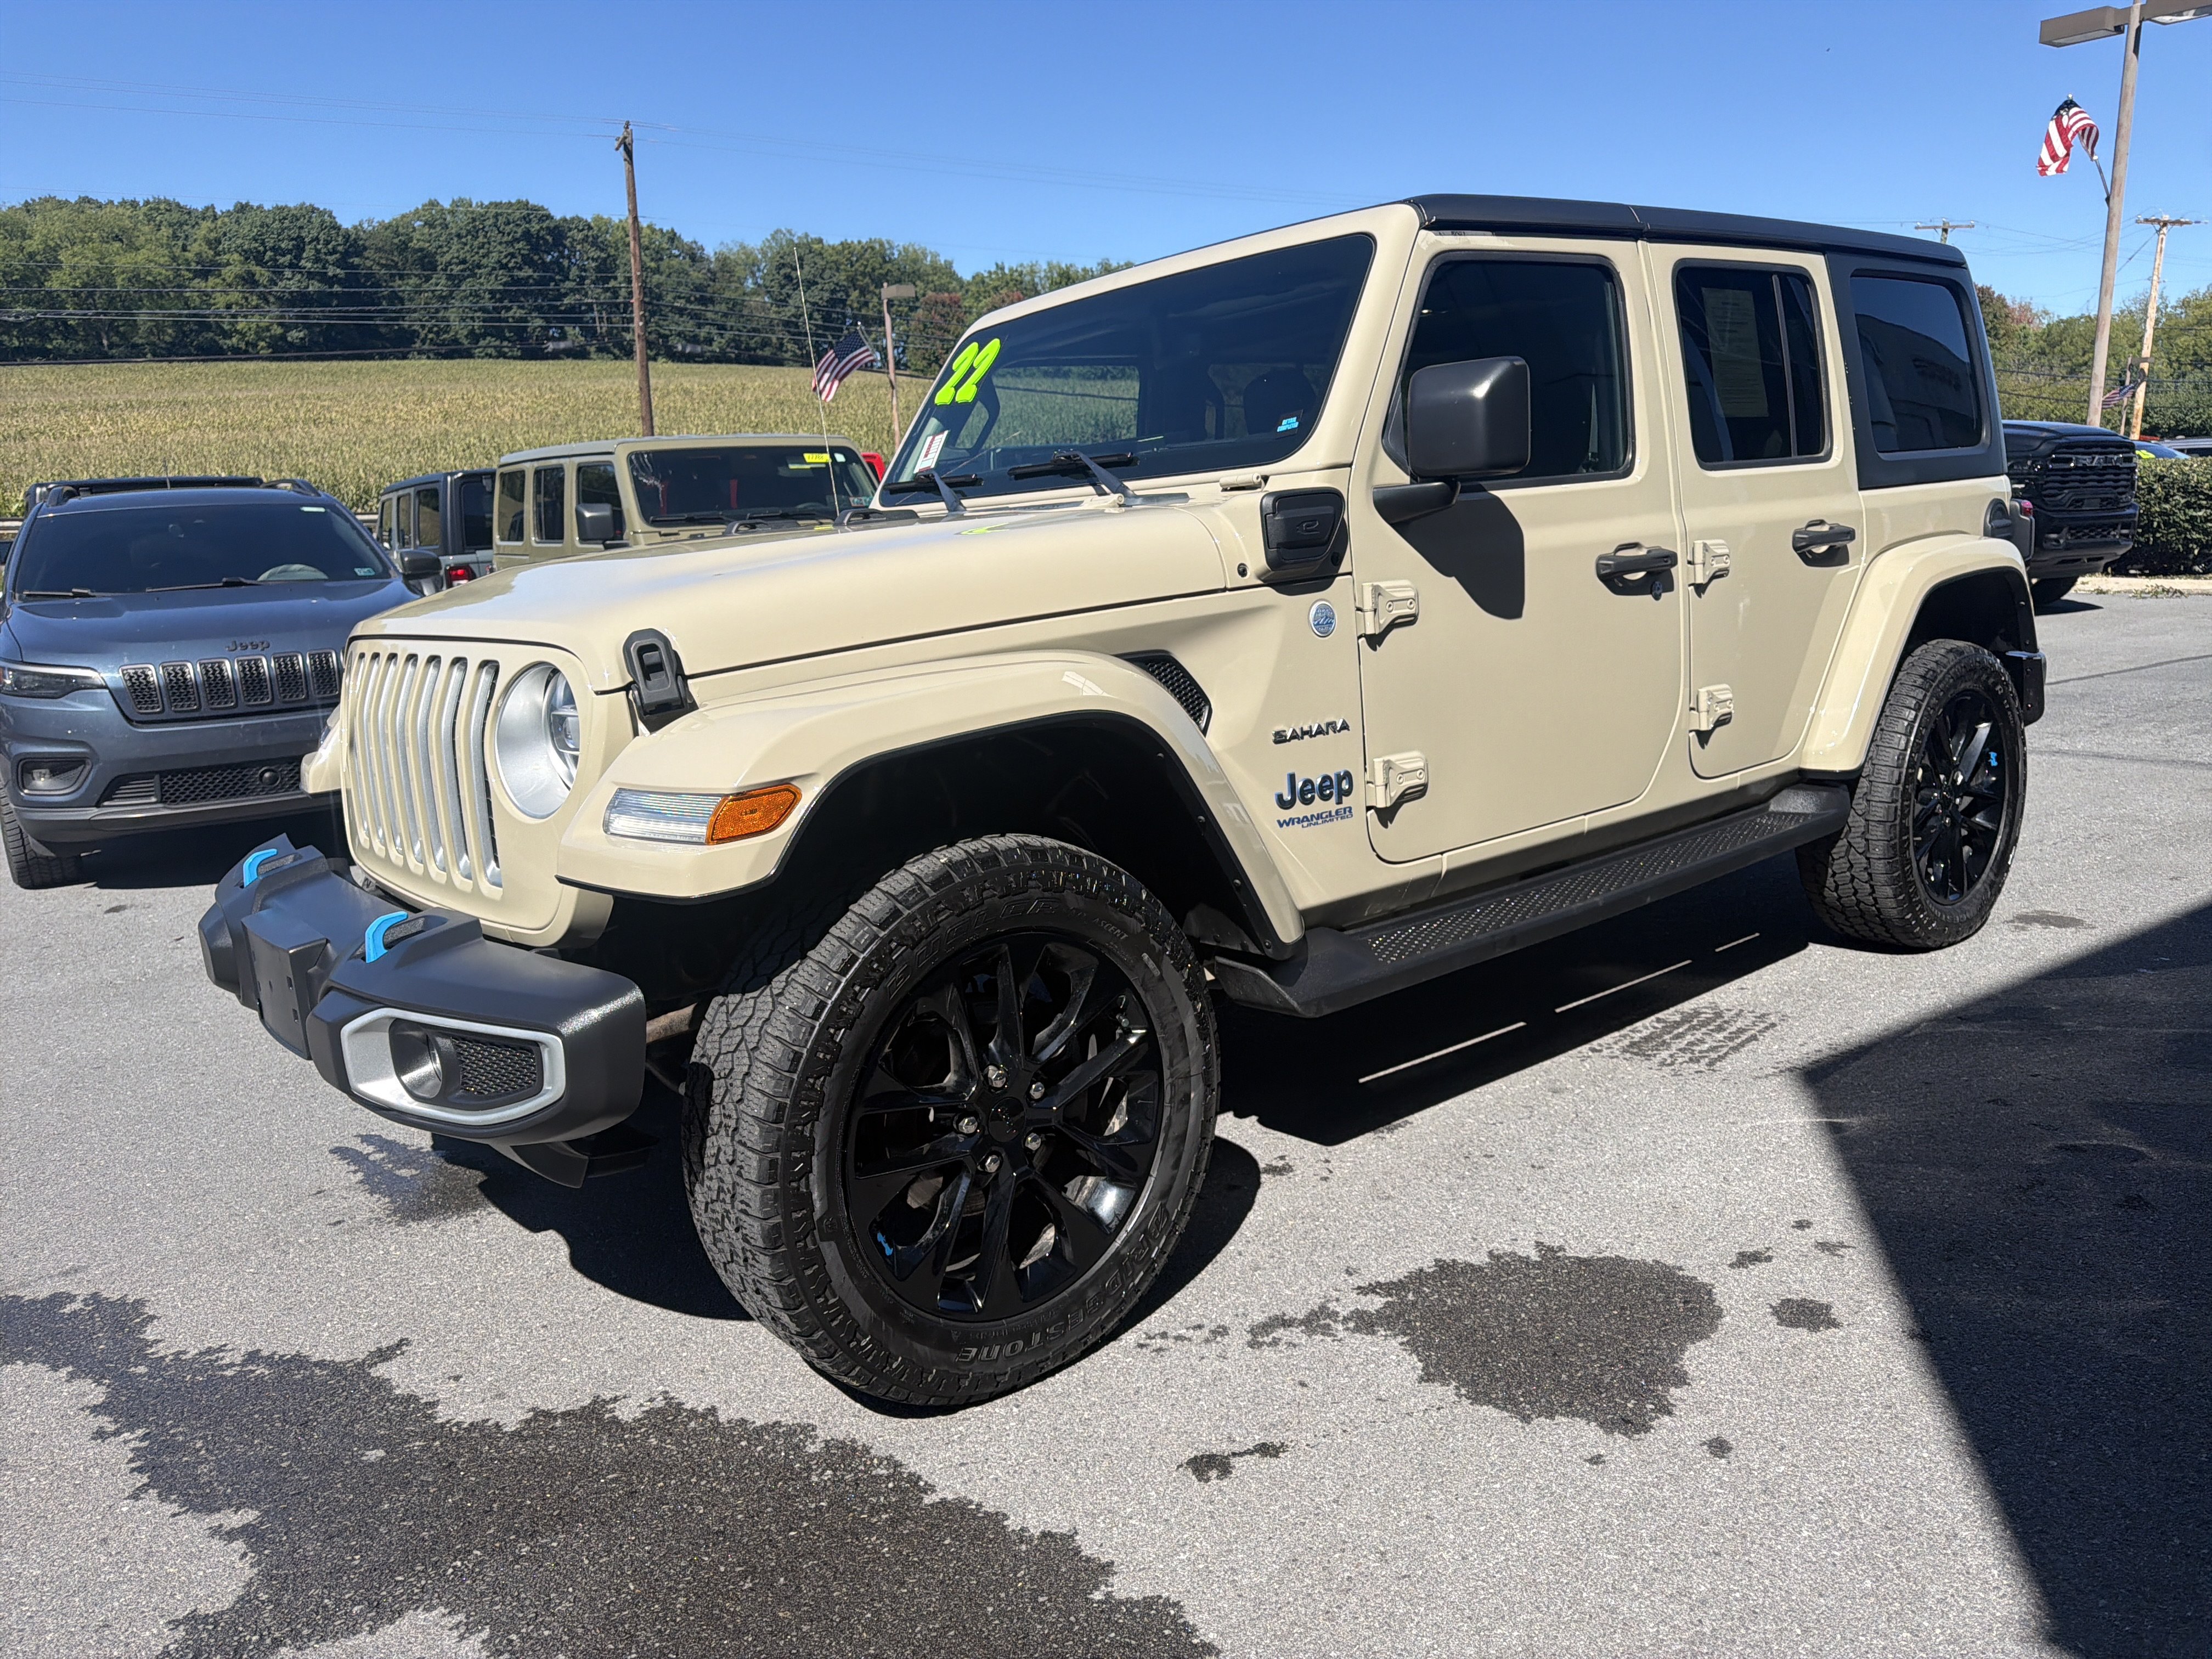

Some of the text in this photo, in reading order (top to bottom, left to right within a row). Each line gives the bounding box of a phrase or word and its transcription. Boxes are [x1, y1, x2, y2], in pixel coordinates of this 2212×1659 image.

[935, 338, 1001, 405] 22
[225, 640, 270, 652] Jeep
[1272, 718, 1350, 744] SAHARA
[1274, 769, 1353, 810] Jeep
[1276, 806, 1353, 828] WRANGLER
[1301, 814, 1353, 828] UNLIMITED
